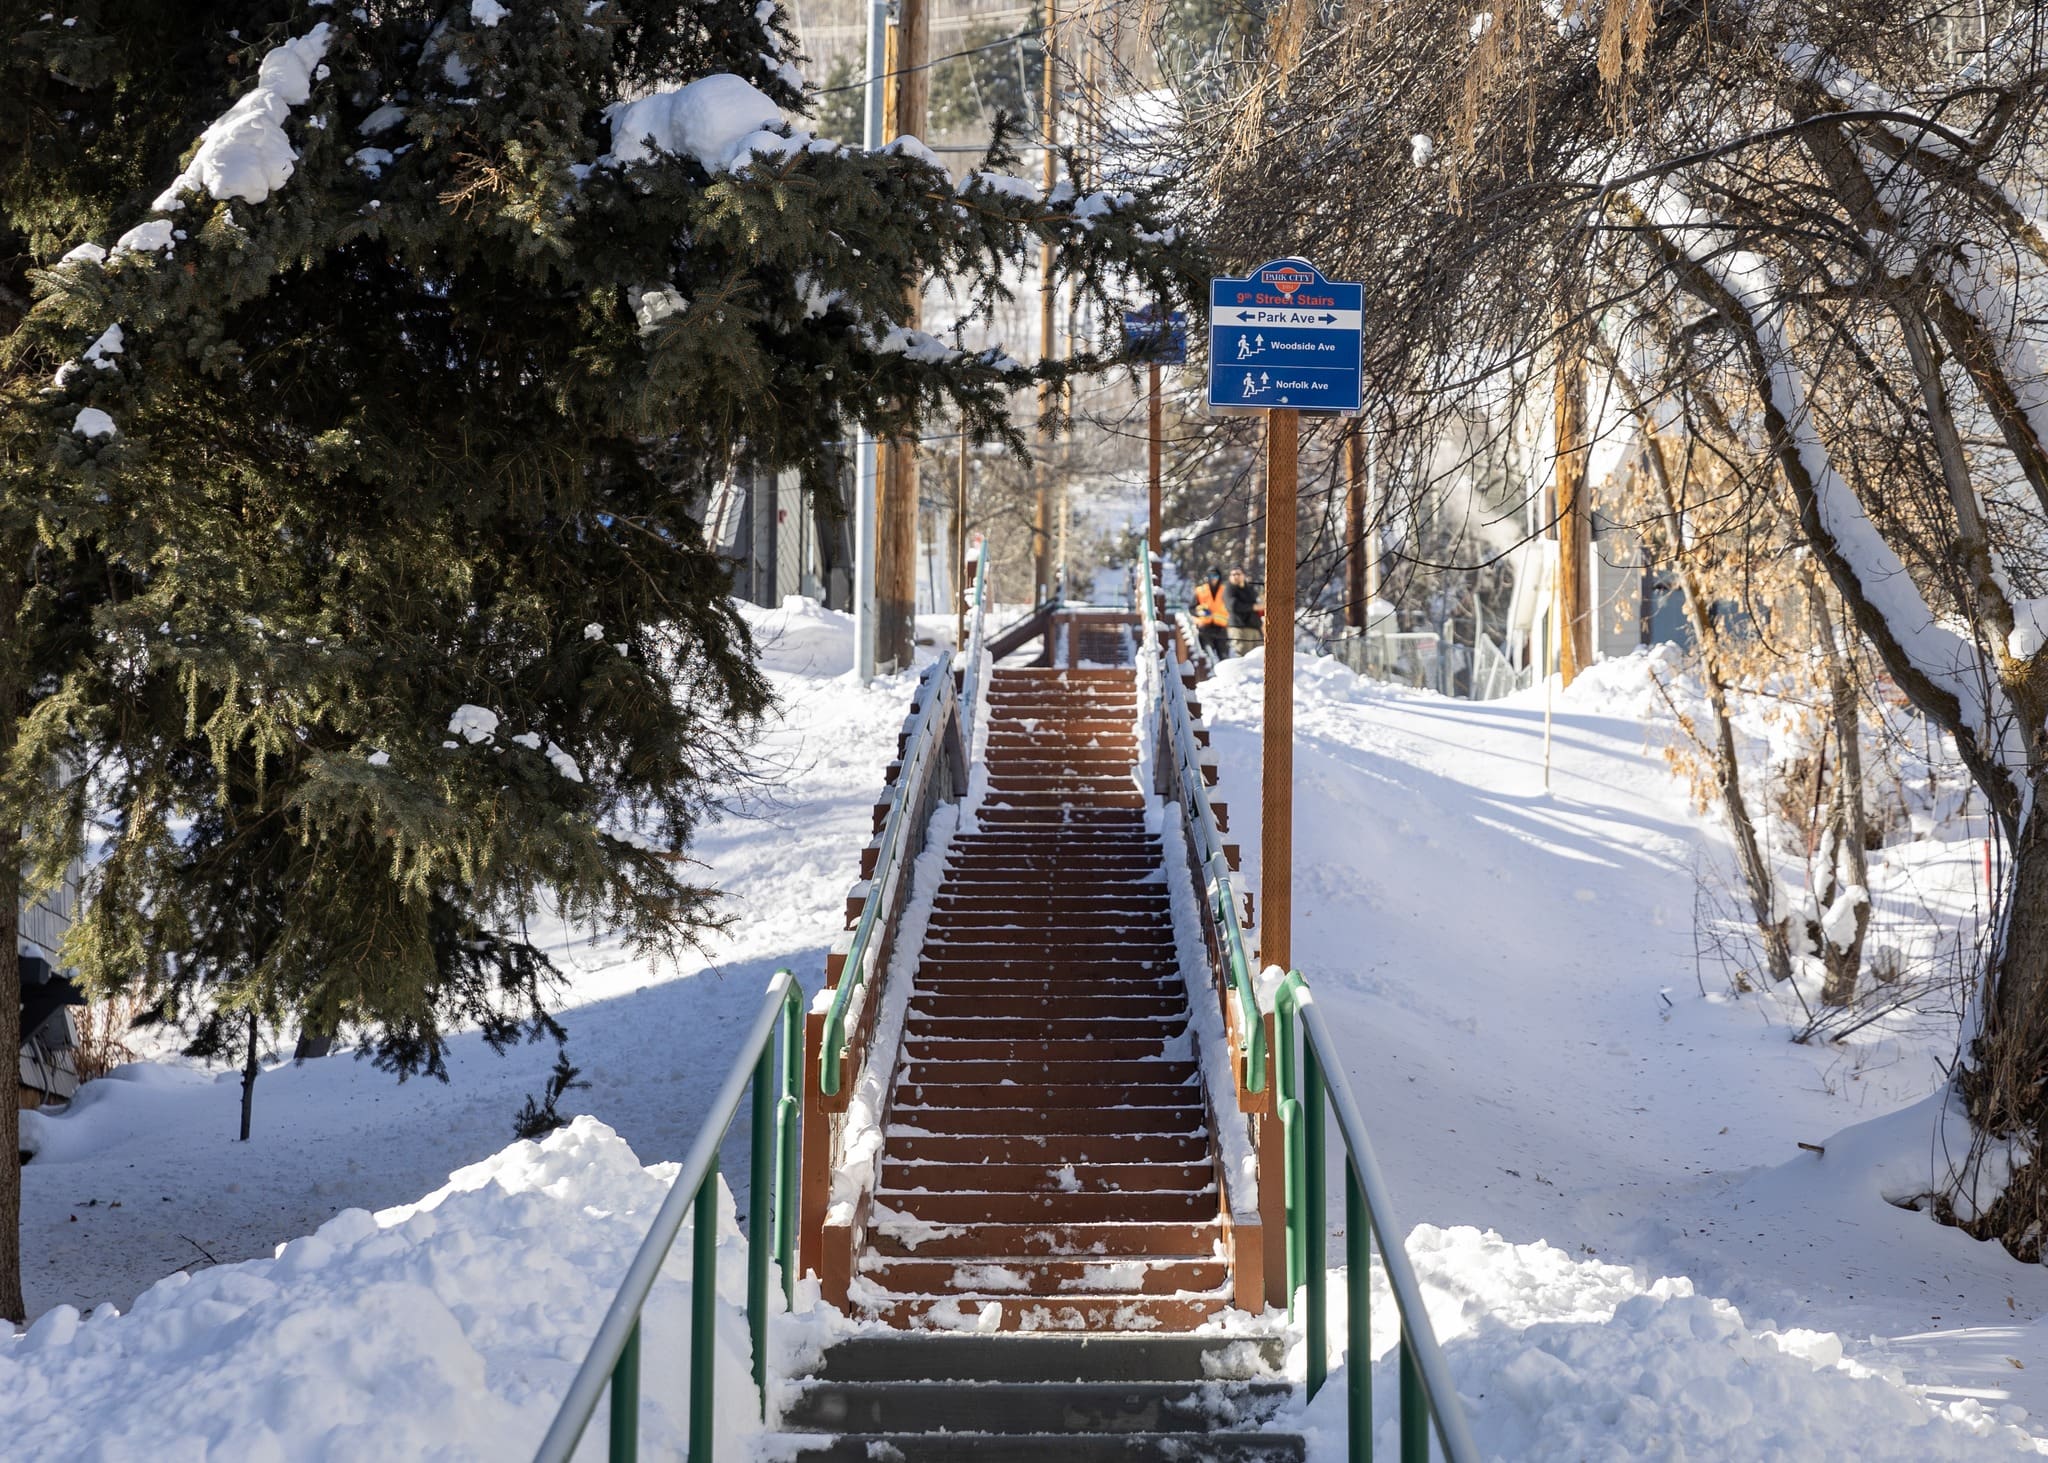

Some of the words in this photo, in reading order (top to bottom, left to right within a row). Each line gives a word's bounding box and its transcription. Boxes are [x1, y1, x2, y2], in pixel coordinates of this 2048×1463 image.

[1265, 273, 1287, 281] PARK
[1289, 274, 1311, 282] CITY
[1237, 292, 1252, 303] 9th
[1256, 293, 1293, 305] Street
[1297, 294, 1335, 306] Stairs
[1258, 312, 1287, 322] Park
[1291, 313, 1315, 323] Ave
[1271, 341, 1316, 351] Woodside
[1317, 343, 1335, 351] Ave
[1276, 380, 1309, 389] Norfolk
[1311, 382, 1329, 390] Ave
